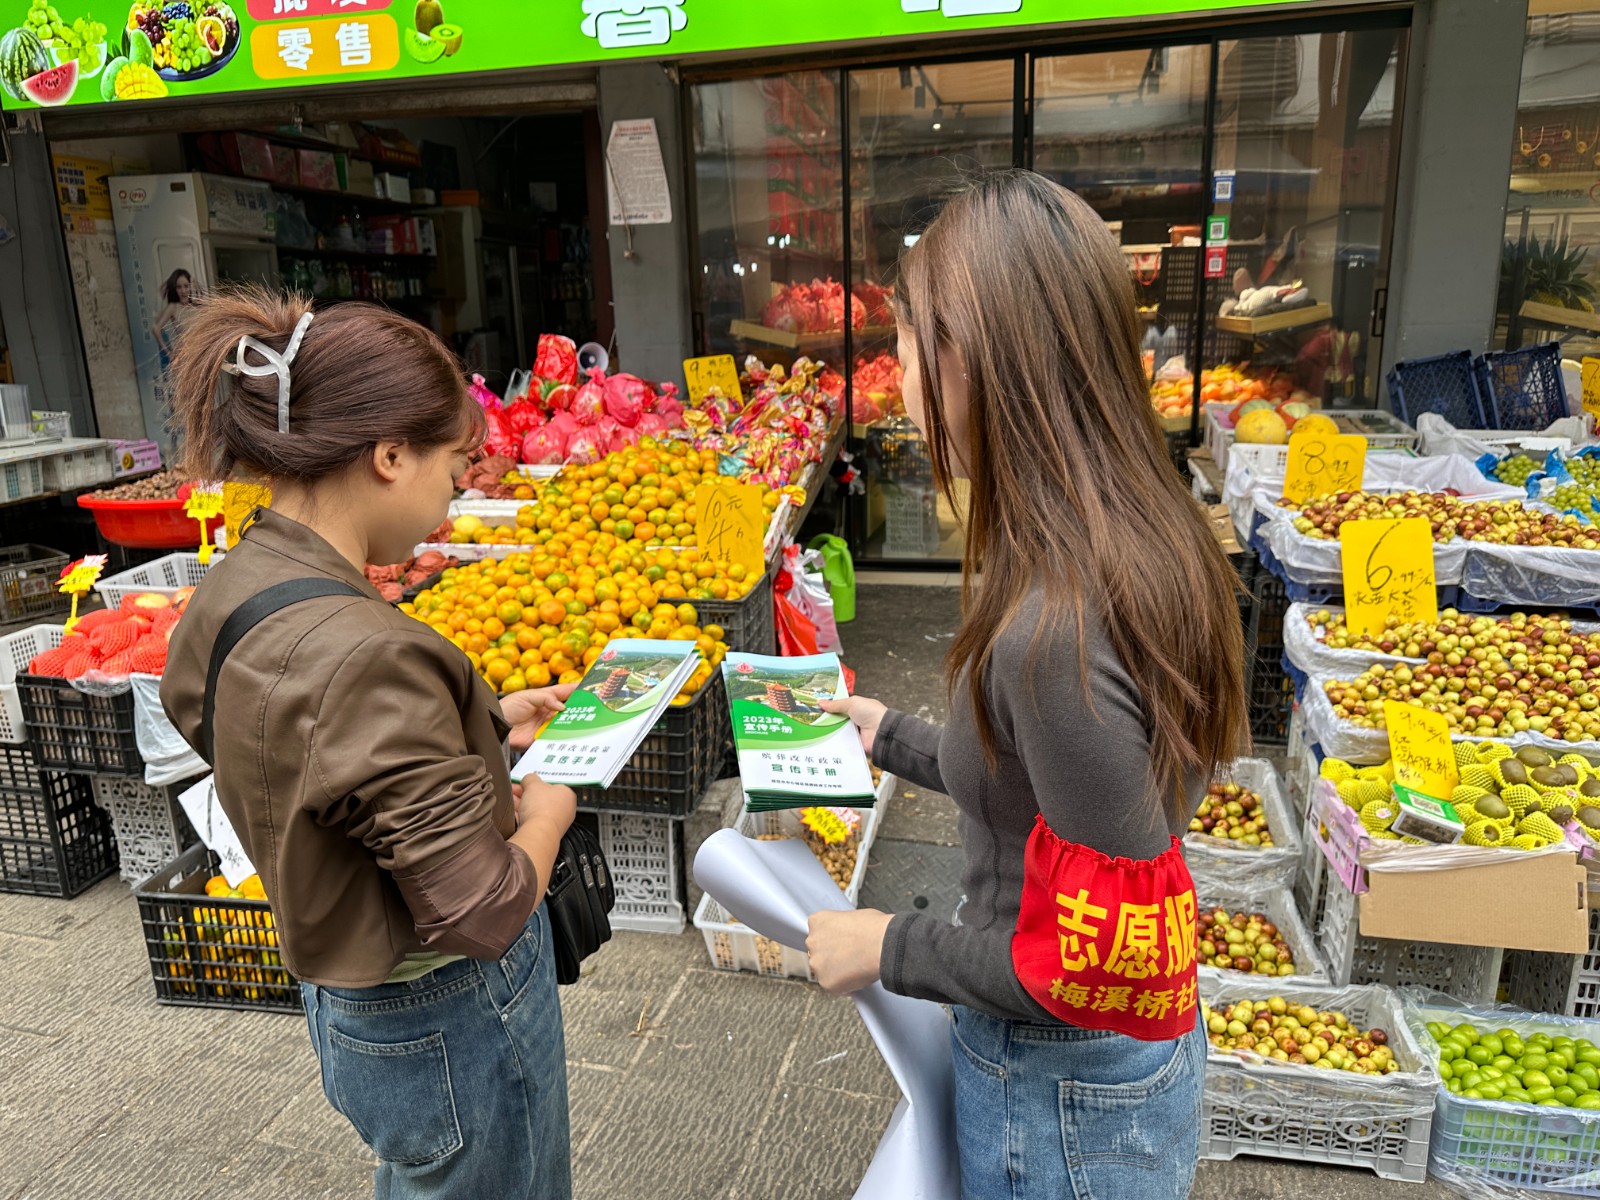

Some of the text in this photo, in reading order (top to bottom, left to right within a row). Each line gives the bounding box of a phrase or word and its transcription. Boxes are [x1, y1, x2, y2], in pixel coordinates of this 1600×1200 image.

[277, 21, 372, 71] 零售
[565, 706, 597, 714] 2023年
[557, 713, 597, 722] 宣传手册
[743, 715, 784, 725] 2023年
[744, 723, 793, 734] 宣传手册
[543, 754, 597, 765] 宣传手册
[771, 763, 837, 777] 宣传手册
[1055, 888, 1197, 980] 志愿服
[1048, 975, 1197, 1020] 梅溪桥社
